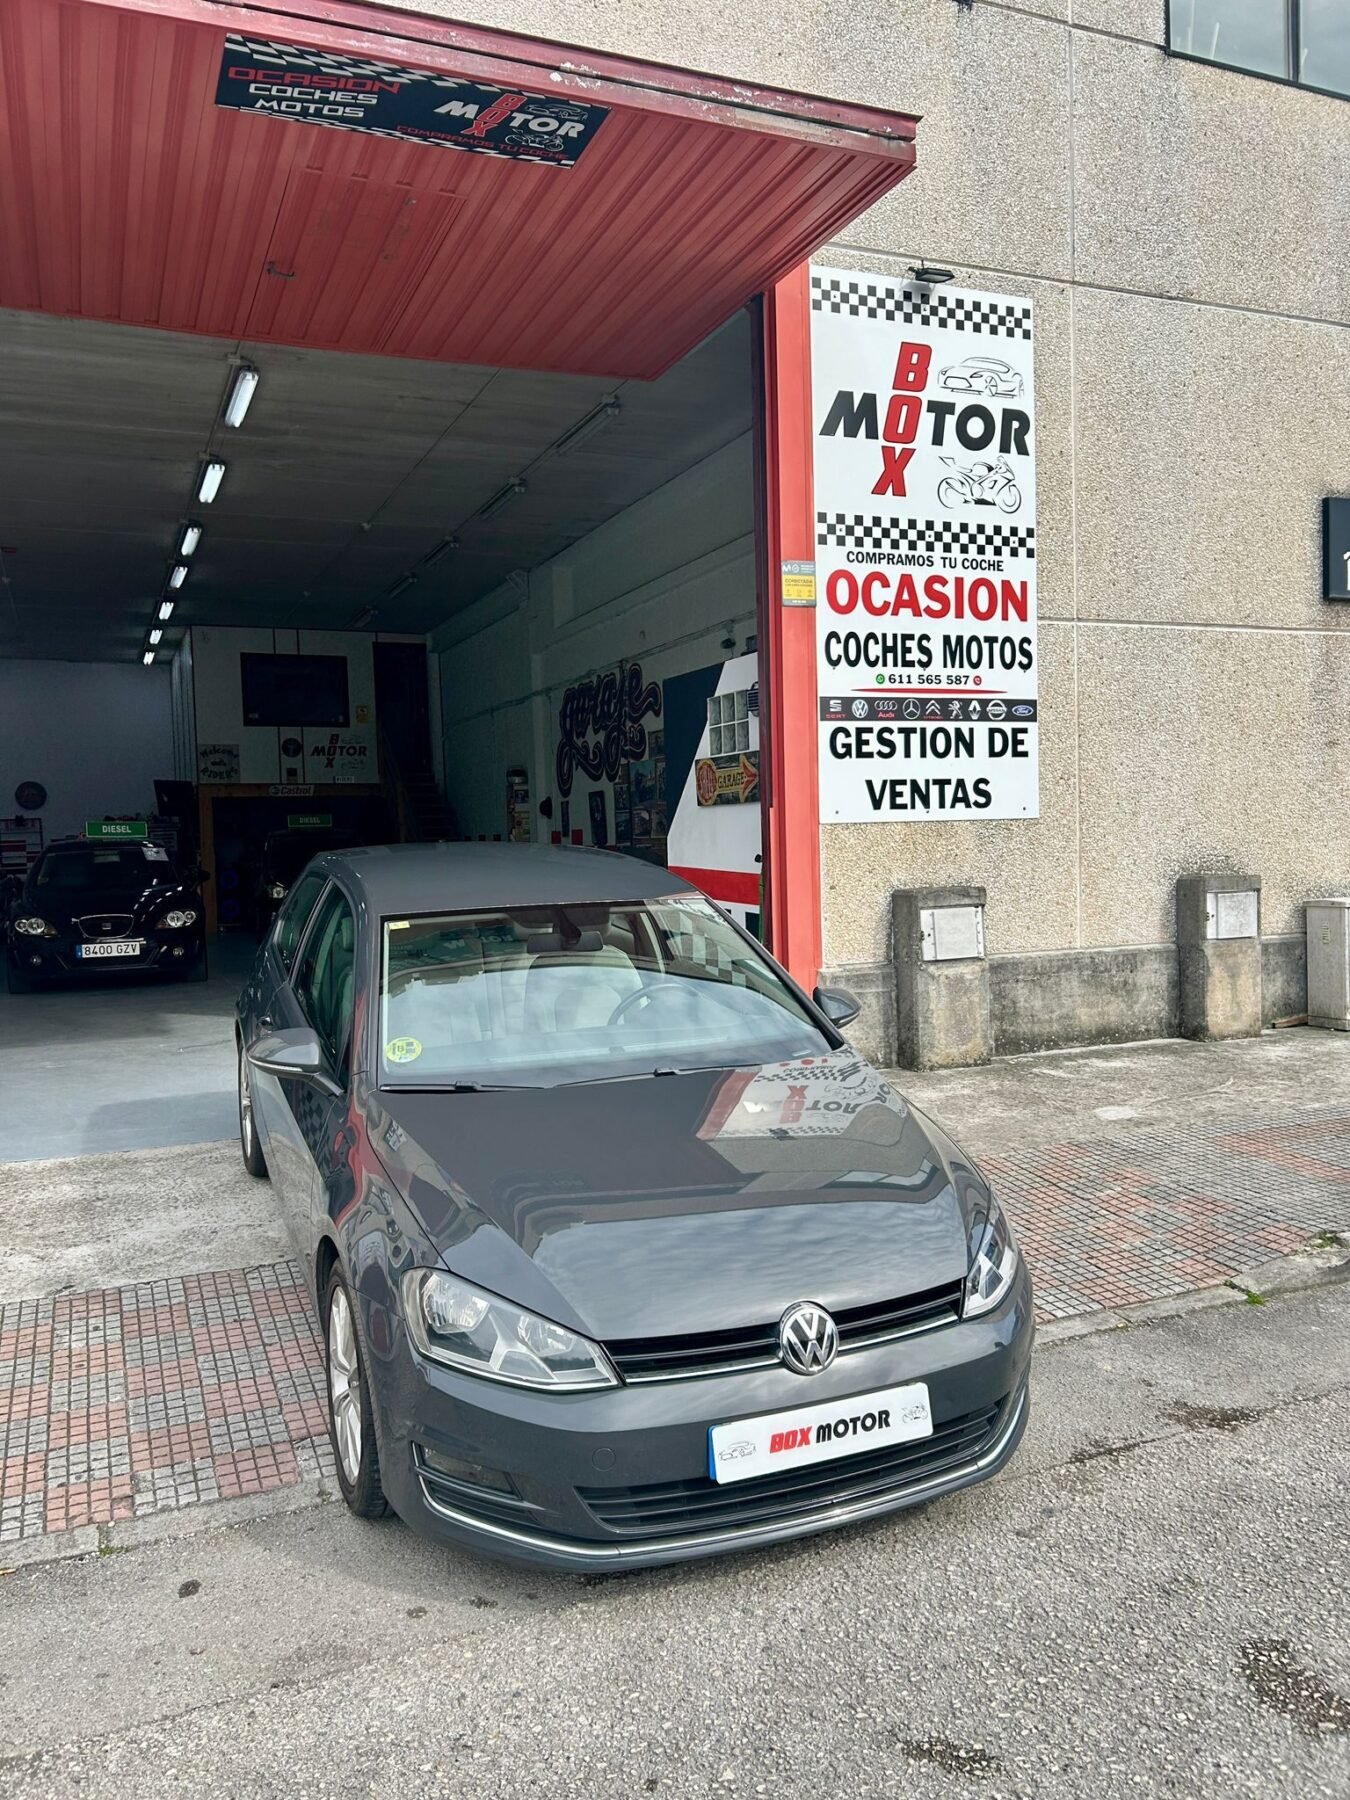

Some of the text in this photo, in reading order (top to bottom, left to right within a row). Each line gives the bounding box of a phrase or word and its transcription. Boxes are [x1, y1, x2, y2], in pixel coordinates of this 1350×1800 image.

[227, 66, 400, 94] OCASION
[248, 82, 378, 105] COCHES
[255, 99, 365, 118] MOTOS
[433, 100, 585, 138] MOTOR
[397, 125, 570, 160] COMPRAMOS TU COCHE
[818, 390, 1031, 456] MOTOR
[871, 341, 933, 497] BOX
[846, 551, 1004, 572] COMPRAMOS TU COCHE
[826, 569, 1028, 622] OCASION
[824, 631, 1033, 671] COCHES MOTOS
[888, 674, 970, 686] 611 565 587
[829, 727, 1029, 759] GESTION DE
[281, 785, 311, 796] Castrol
[865, 778, 992, 810] VENTAS
[102, 825, 132, 833] DIESEL
[84, 943, 137, 956] 8400 GZV
[769, 1409, 891, 1453] BOX MOTOR
